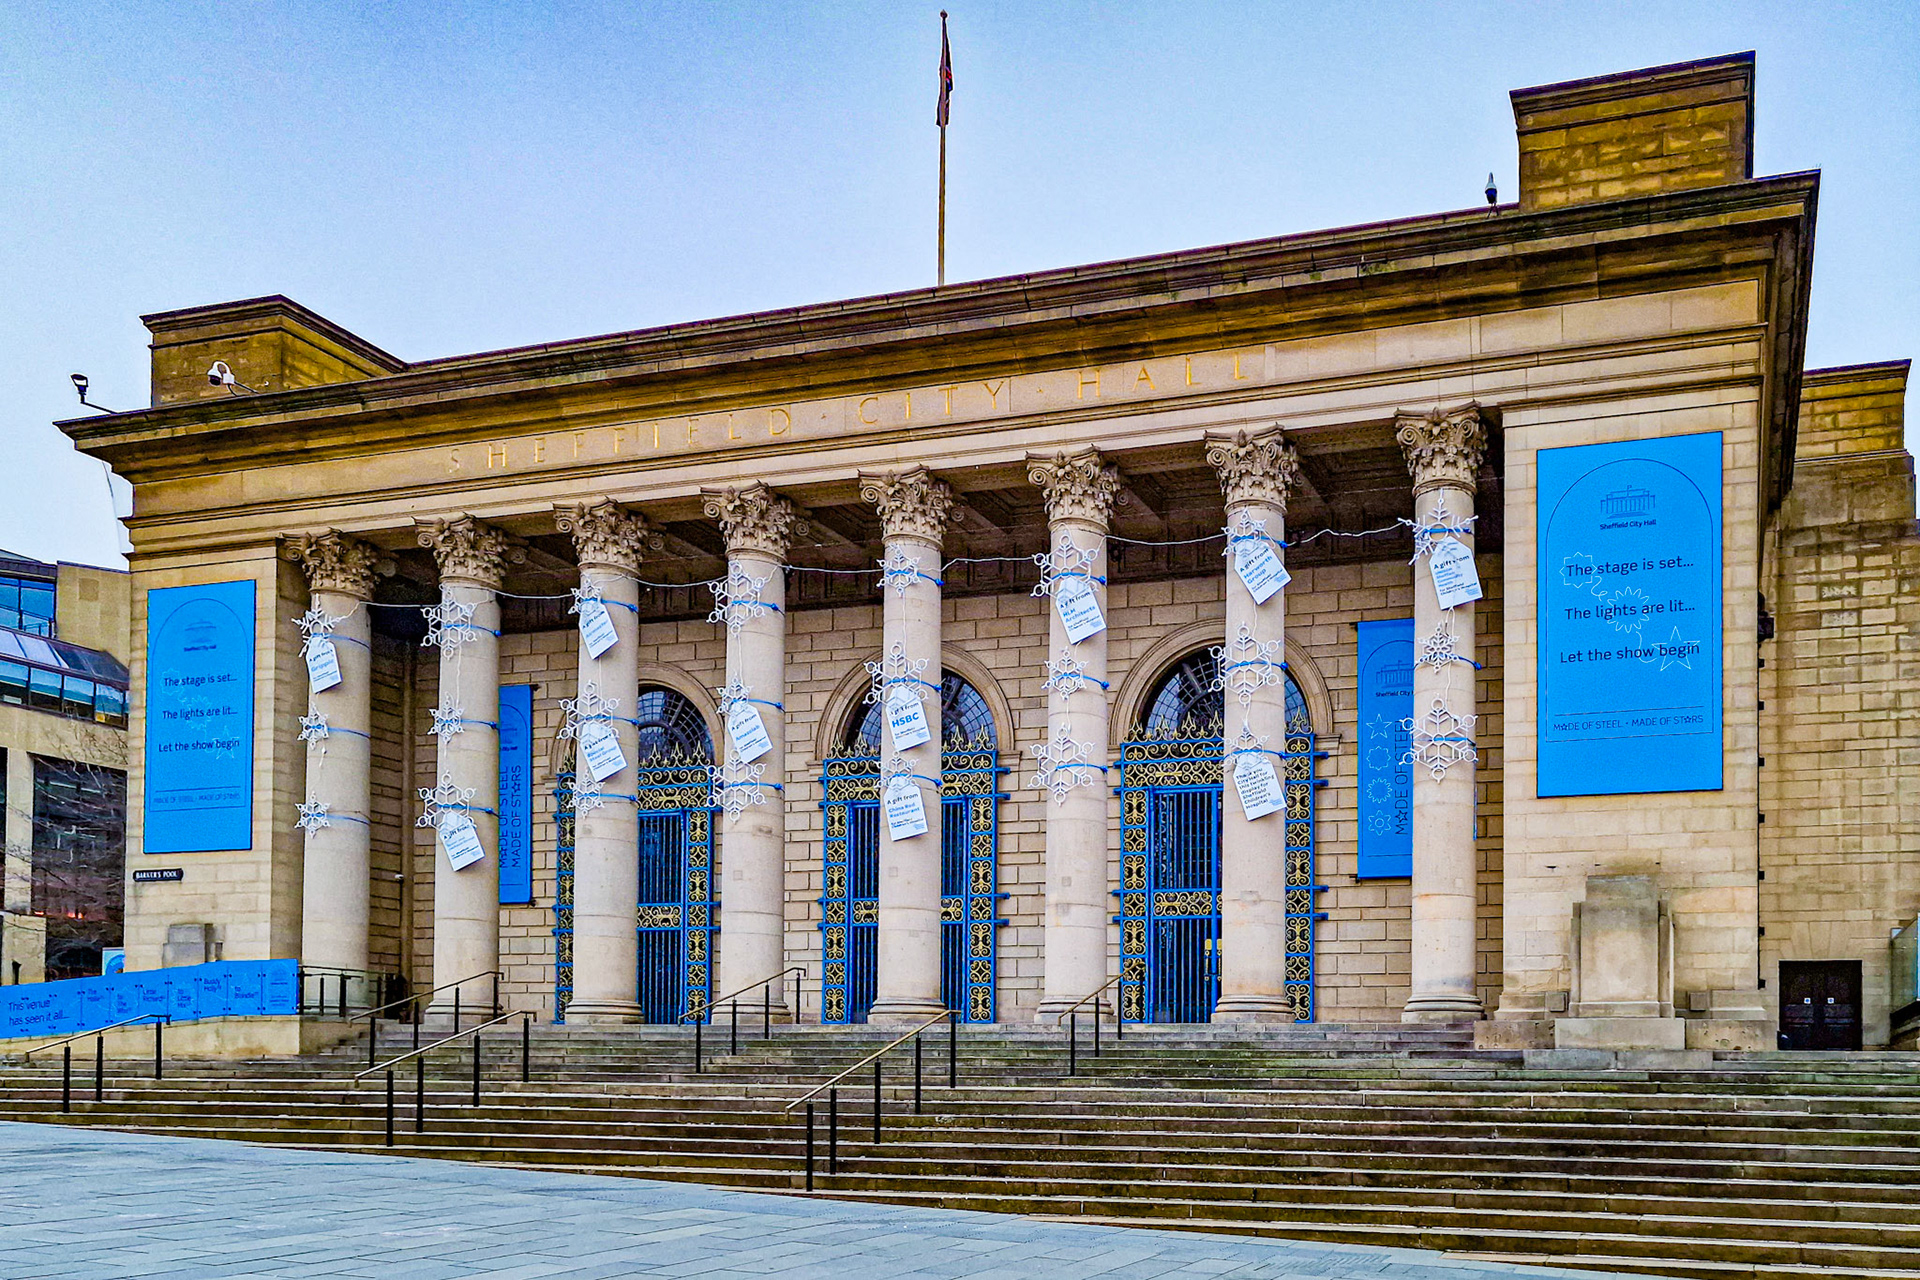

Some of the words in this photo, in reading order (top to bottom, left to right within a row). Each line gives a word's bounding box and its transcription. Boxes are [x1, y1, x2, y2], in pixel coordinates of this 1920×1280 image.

[449, 408, 791, 473] SHEFFIELD
[858, 381, 1004, 424] CITY
[1077, 352, 1249, 399] HALL
[1600, 522, 1628, 530] Sheffield
[1245, 559, 1255, 569] gift
[1254, 548, 1269, 559] from
[1440, 561, 1451, 569] gift
[1566, 564, 1593, 576] The
[1597, 561, 1638, 575] stage
[1642, 558, 1654, 570] is
[1659, 556, 1694, 568] set...
[1244, 556, 1273, 578] Harworth
[1247, 569, 1266, 584] Group
[1066, 605, 1095, 622] Architects
[1564, 608, 1591, 619] The
[1596, 604, 1637, 620] lights
[1642, 603, 1664, 613] are
[1669, 599, 1695, 611] lit...
[1560, 651, 1583, 663] Let
[1588, 649, 1611, 660] the
[1617, 646, 1654, 659] show
[1659, 642, 1699, 657] begin
[164, 677, 179, 686] The
[182, 675, 205, 686] stage
[208, 674, 214, 682] is
[162, 710, 178, 719] The
[180, 709, 204, 720] lights
[892, 712, 919, 727] HSBC
[1582, 721, 1594, 730] OF
[1596, 719, 1623, 729] STEEL
[1632, 717, 1657, 726] MADE
[1660, 716, 1671, 725] OF
[158, 744, 172, 752] Let
[175, 742, 189, 751] the
[192, 740, 214, 750] show
[216, 738, 240, 750] begin
[1395, 765, 1408, 784] OF
[1241, 785, 1260, 794] display
[511, 812, 521, 827] OF
[890, 807, 920, 817] Restaurant
[511, 831, 521, 867] MADE
[8, 1002, 24, 1011] This
[25, 1000, 50, 1009] venue
[9, 1016, 23, 1026] has
[25, 1015, 44, 1024] seen
[46, 1012, 52, 1021] it
